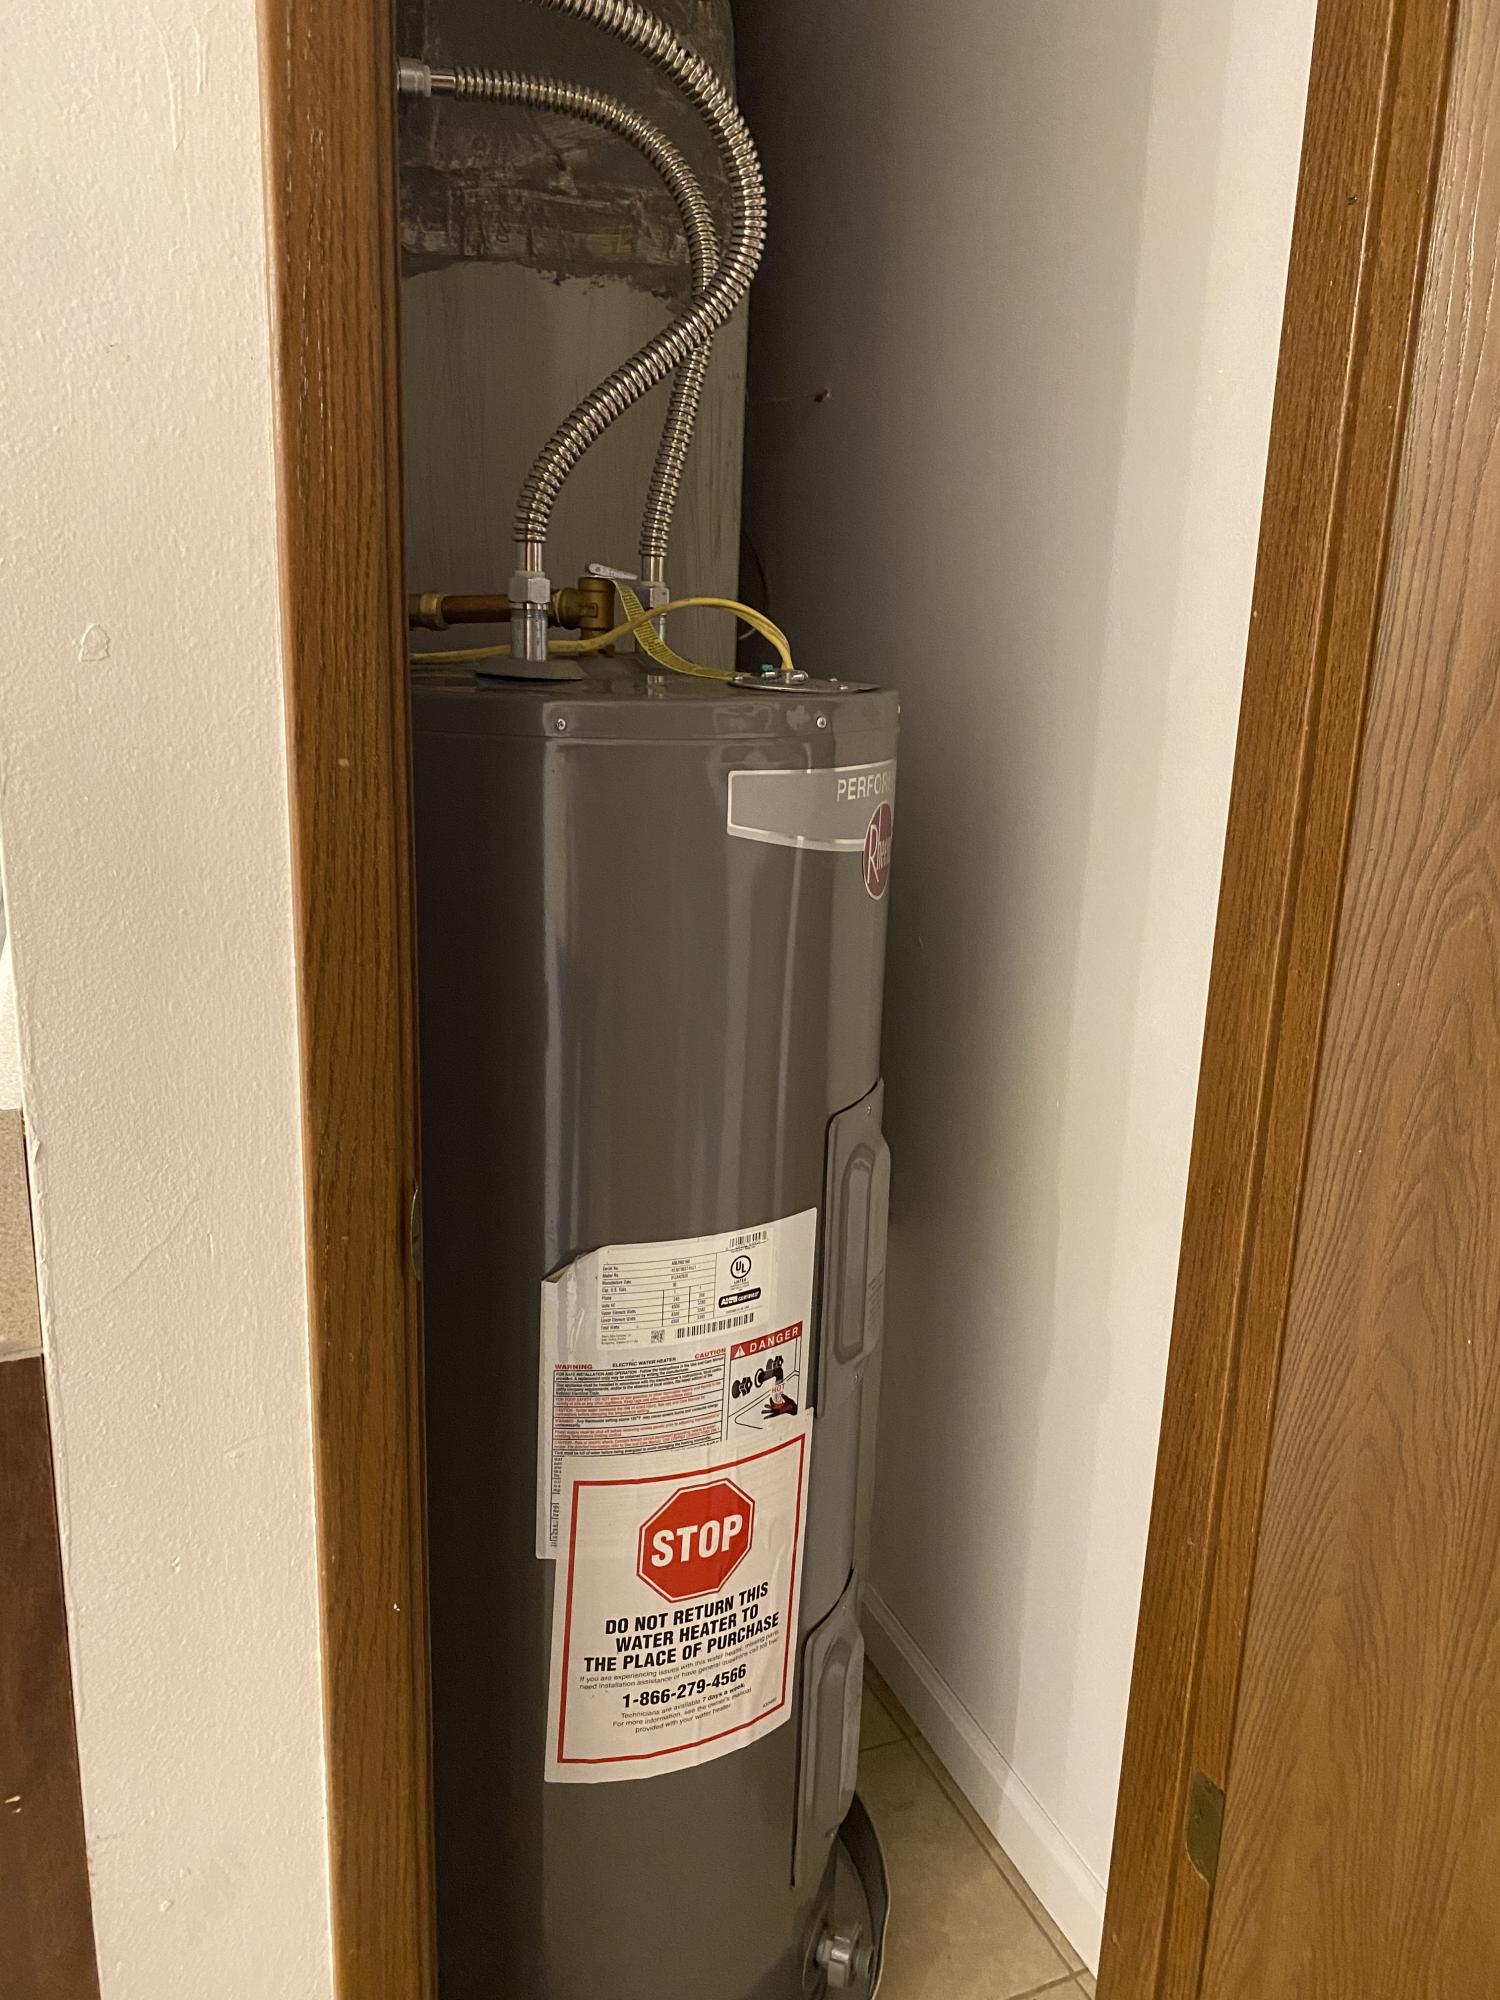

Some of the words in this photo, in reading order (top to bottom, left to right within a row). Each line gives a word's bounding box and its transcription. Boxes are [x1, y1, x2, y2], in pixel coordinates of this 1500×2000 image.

[735, 1261, 747, 1273] UL
[694, 1348, 726, 1359] CAUTION
[749, 1326, 799, 1353] DANGER
[651, 1513, 743, 1568] STOP
[605, 1618, 629, 1635] DO
[634, 1613, 668, 1632] NOT
[673, 1596, 734, 1626] RETURN
[738, 1581, 769, 1606] THIS
[584, 1657, 617, 1672] THE
[623, 1648, 677, 1670] PLACE
[682, 1642, 702, 1661] OF
[707, 1612, 779, 1654] PURCHASE
[615, 1630, 674, 1653] WATER
[679, 1613, 737, 1643] HEATER
[742, 1604, 759, 1623] TO
[586, 1676, 599, 1684] you
[613, 1670, 657, 1681] experiencing
[658, 1666, 679, 1675] issues
[680, 1662, 694, 1670] with
[694, 1658, 706, 1667] this
[707, 1653, 724, 1663] water
[598, 1681, 636, 1689] installation
[636, 1675, 672, 1686] assistance
[681, 1670, 697, 1678] have
[698, 1663, 721, 1674] general
[722, 1651, 749, 1666] questions
[622, 1663, 747, 1708] 1-866-279-4566
[696, 1705, 707, 1713] the
[731, 1687, 752, 1699] manual
[621, 1710, 660, 1719] Technicians
[673, 1699, 701, 1710] available
[707, 1692, 723, 1701] days
[635, 1723, 664, 1734] provided
[679, 1716, 694, 1724] your
[694, 1711, 712, 1720] water
